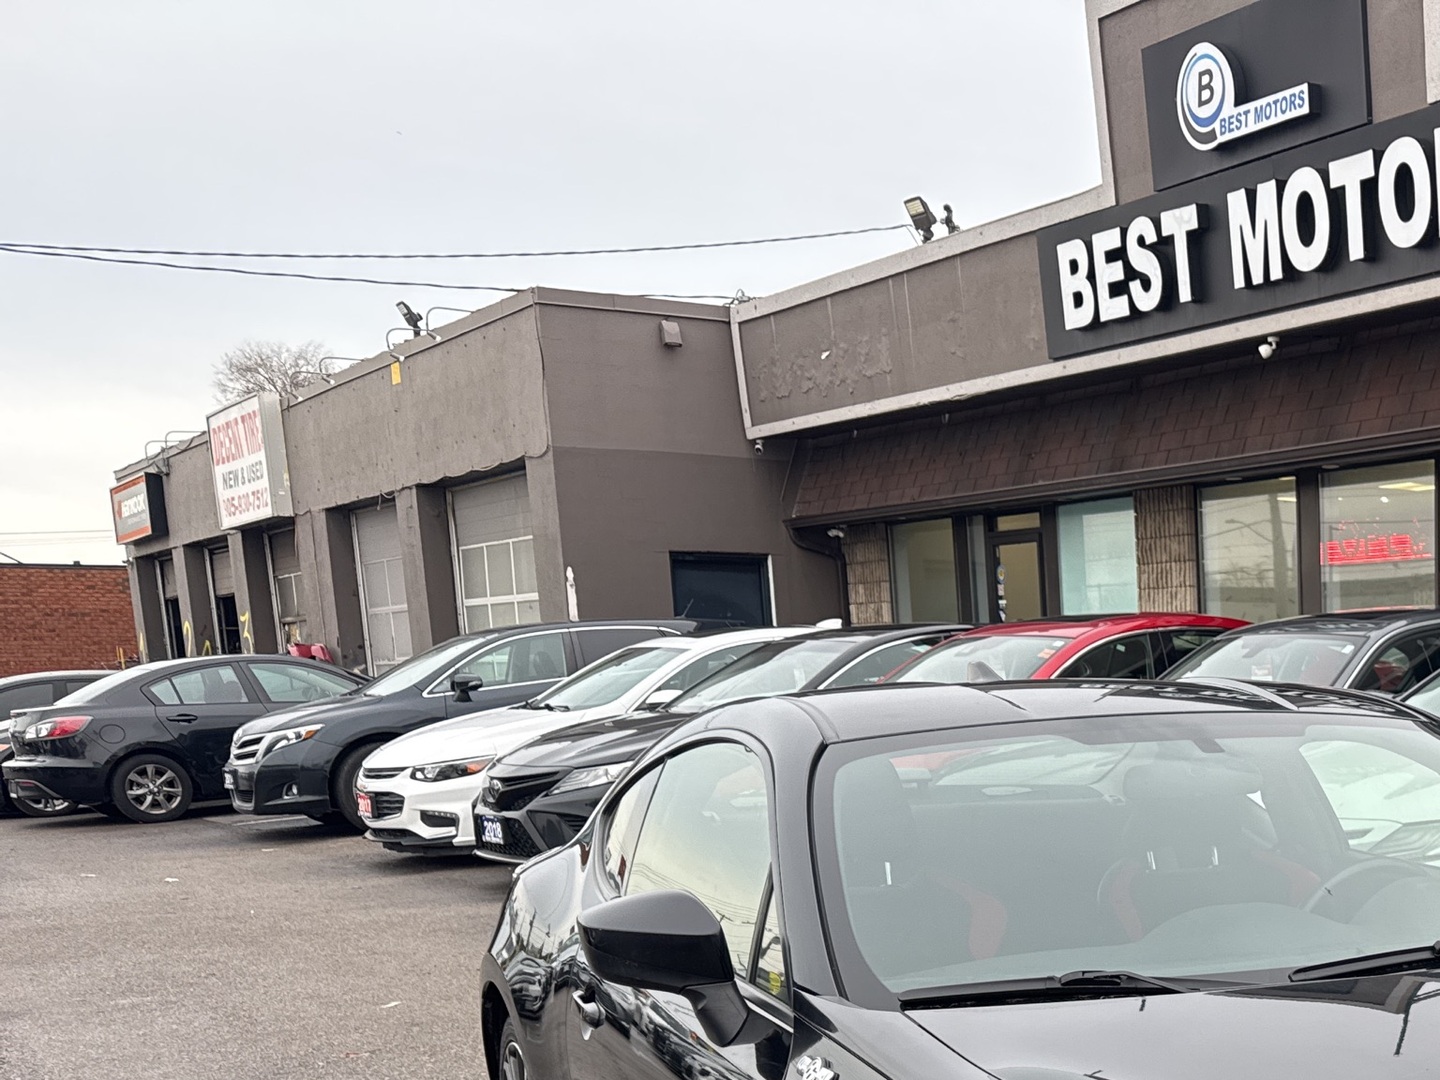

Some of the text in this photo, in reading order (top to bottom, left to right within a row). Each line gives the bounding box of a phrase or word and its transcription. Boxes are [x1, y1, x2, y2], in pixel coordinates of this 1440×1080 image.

[1198, 68, 1215, 108] B
[1219, 89, 1305, 136] BEST MOTORS
[1056, 203, 1198, 330] BEST
[211, 416, 244, 466] DECENT
[222, 460, 264, 490] NEW & USED
[483, 820, 503, 837] 2018
